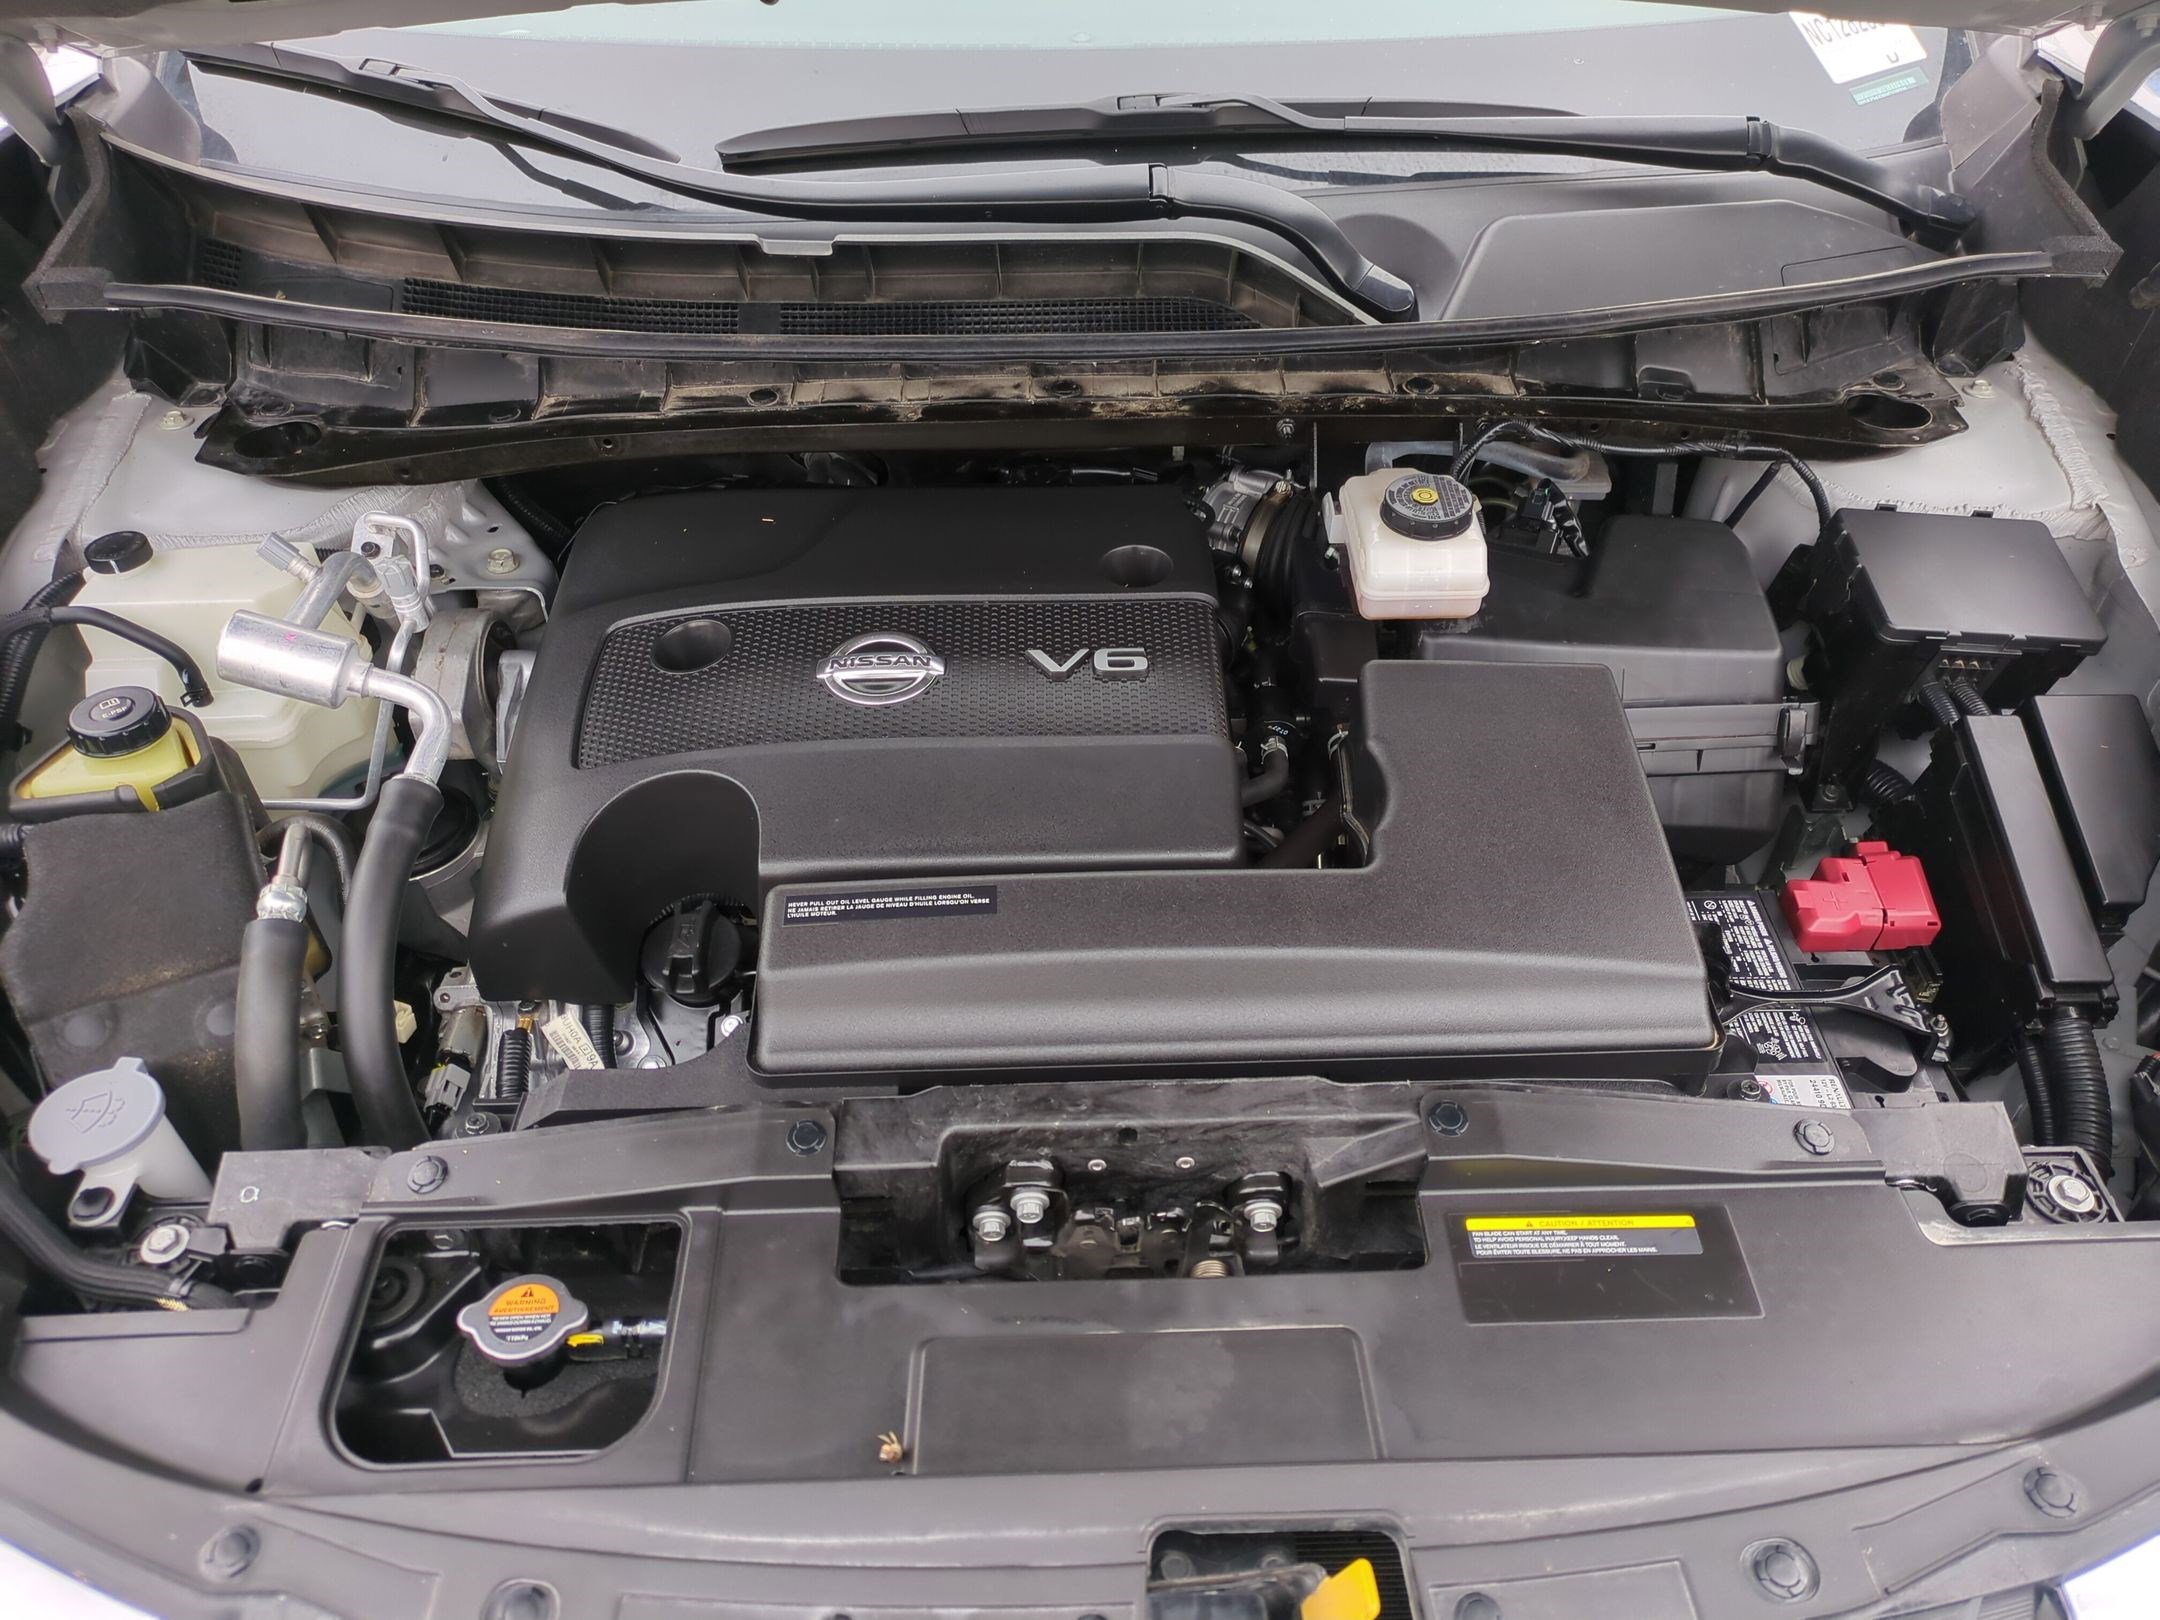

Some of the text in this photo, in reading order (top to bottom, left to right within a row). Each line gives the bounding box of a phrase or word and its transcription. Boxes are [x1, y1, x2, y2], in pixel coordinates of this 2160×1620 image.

[830, 655, 932, 669] NISSAN
[1024, 647, 1149, 682] V6
[506, 1298, 546, 1306] WARNING
